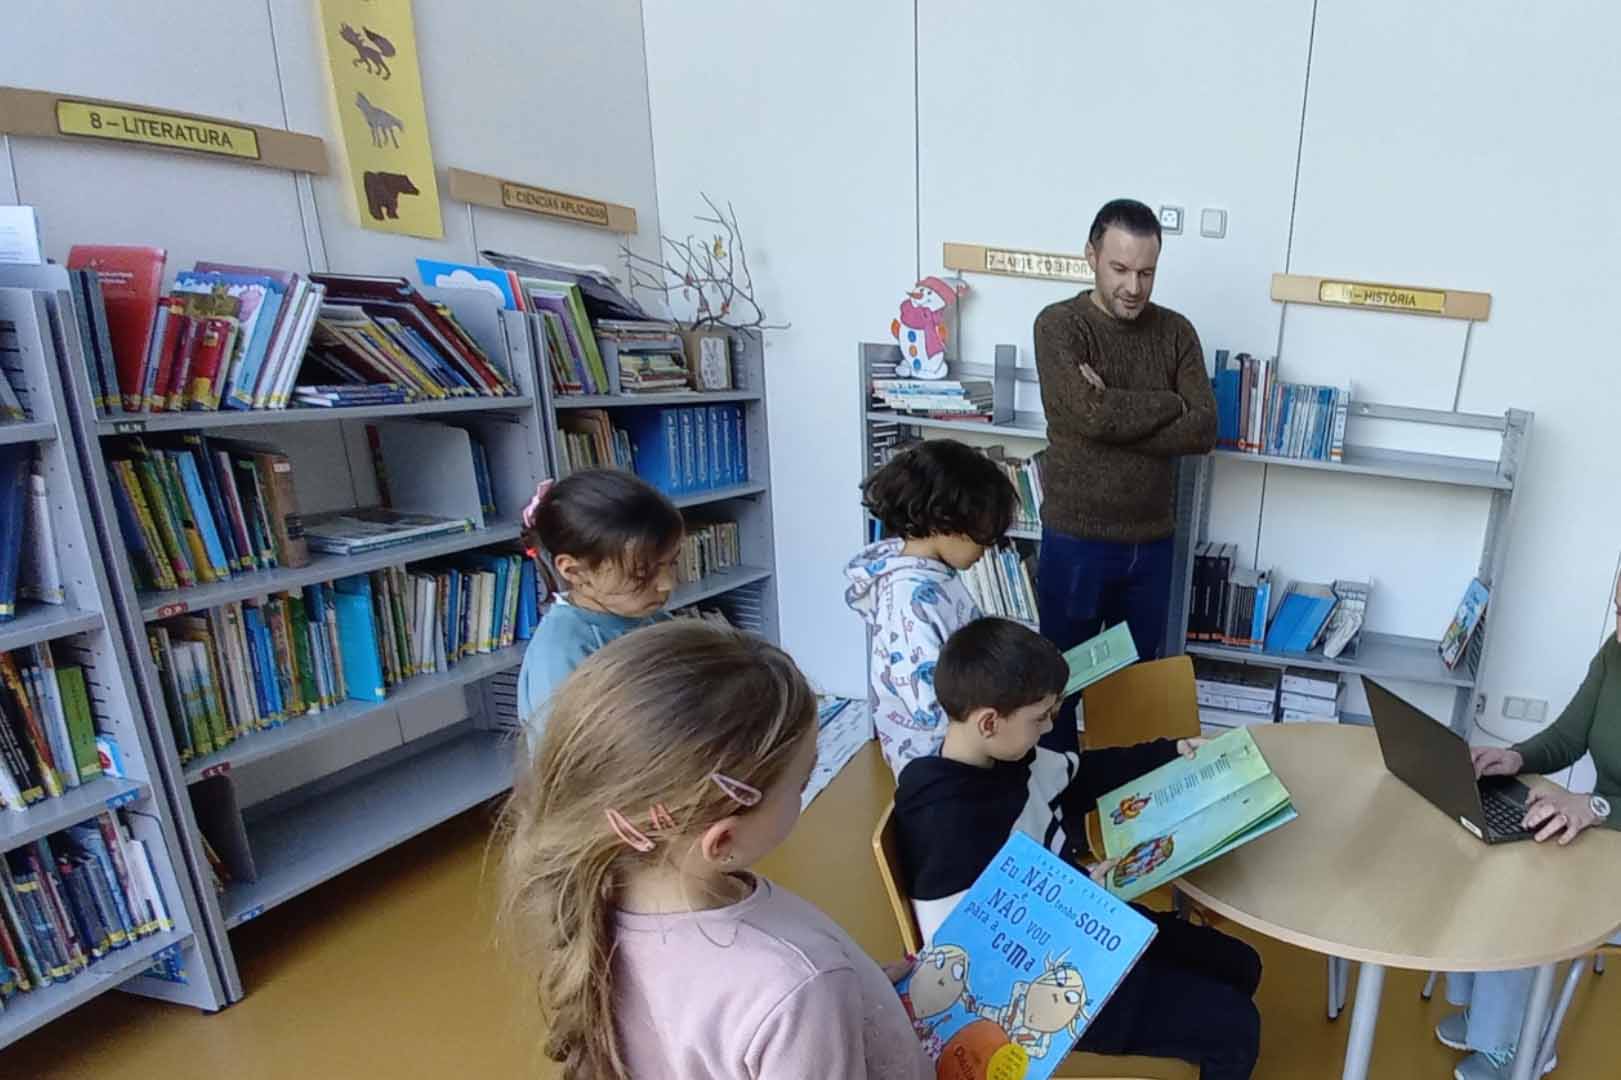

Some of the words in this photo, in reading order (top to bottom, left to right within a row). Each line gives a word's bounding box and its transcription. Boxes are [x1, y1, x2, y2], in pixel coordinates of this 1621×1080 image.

[89, 112, 102, 129] 8
[122, 116, 233, 148] LITERATURA
[1364, 289, 1416, 306] HISTÓRIA
[964, 901, 990, 926] para
[989, 920, 1000, 931] a
[987, 887, 1027, 925] NÃO
[1000, 856, 1020, 879] Eu
[1021, 866, 1062, 903] NÃO
[1075, 911, 1122, 952] sono
